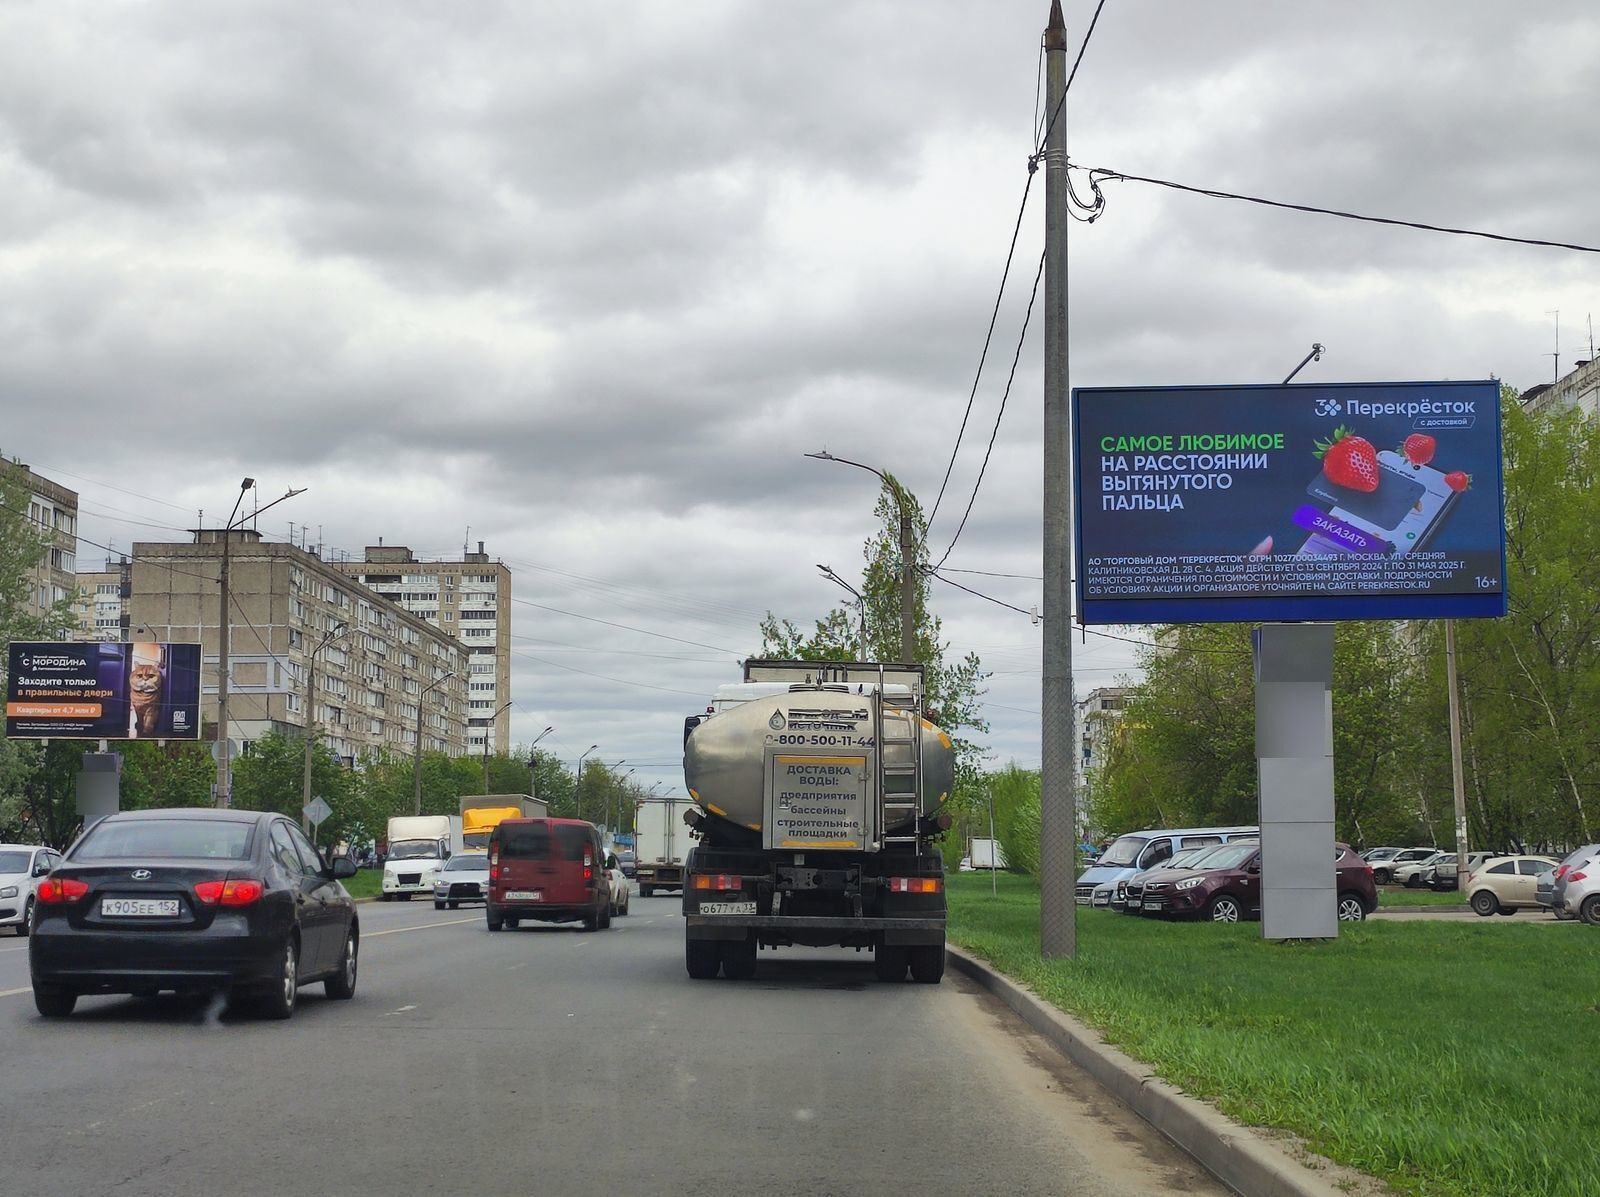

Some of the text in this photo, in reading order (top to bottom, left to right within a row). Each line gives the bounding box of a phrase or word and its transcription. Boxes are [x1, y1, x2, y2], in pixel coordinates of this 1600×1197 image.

[1347, 399, 1475, 418] Перекрёсток
[1427, 418, 1468, 427] доставкой
[1101, 433, 1284, 452] САМОЕ ЛЮБИМОЕ
[1101, 456, 1129, 472] НА
[1134, 453, 1268, 471] РАССТОЯНИИ
[1102, 473, 1232, 491] ВЫТЯНУТОГО
[1103, 494, 1184, 512] ПАЛЬЦА
[1312, 517, 1366, 547] ЗАКАЗАТЬ
[1156, 557, 1176, 565] ДОМ
[1274, 554, 1338, 562] 1027700034493
[1348, 553, 1387, 561] МОСКВА,
[1405, 552, 1446, 560] СРЕДНЯЯ
[1088, 566, 1170, 575] КАЛИТНИКОВСКАЯ
[1215, 565, 1244, 573] АКЦИЯ
[1246, 563, 1294, 573] ДЕЙСТВУЕТ
[1316, 563, 1359, 571] СЕНТЯБРЯ
[1392, 562, 1405, 570] ПО
[1439, 561, 1458, 569] 2025
[1088, 576, 1132, 584] ИМЕЮТСЯ
[1135, 575, 1197, 583] ОГРАНИЧЕНИЯ
[1214, 574, 1270, 582] СТОИМОСТИ
[1281, 573, 1330, 581] УСЛОВИЯМ
[1384, 571, 1452, 580] ПОДРОБНОСТИ
[1475, 576, 1497, 588] 16+
[1089, 586, 1102, 594] ОБ
[1103, 585, 1151, 593] УСЛОВИЯХ
[1153, 585, 1182, 593] АКЦИИ
[1193, 583, 1259, 592] ОРГАНИЗАТОРЕ
[1261, 582, 1312, 591] УТОЧНЯЙТЕ
[1328, 581, 1356, 589] САЙТЕ
[1358, 581, 1430, 589] PEREKRESTOK.RU
[18, 677, 62, 686] Заходите
[787, 765, 851, 775] ДОСТАВКА
[800, 777, 839, 786] ВОДЫ:
[791, 805, 846, 815] бассейны
[777, 819, 858, 828] строительные
[788, 829, 847, 838] площадки
